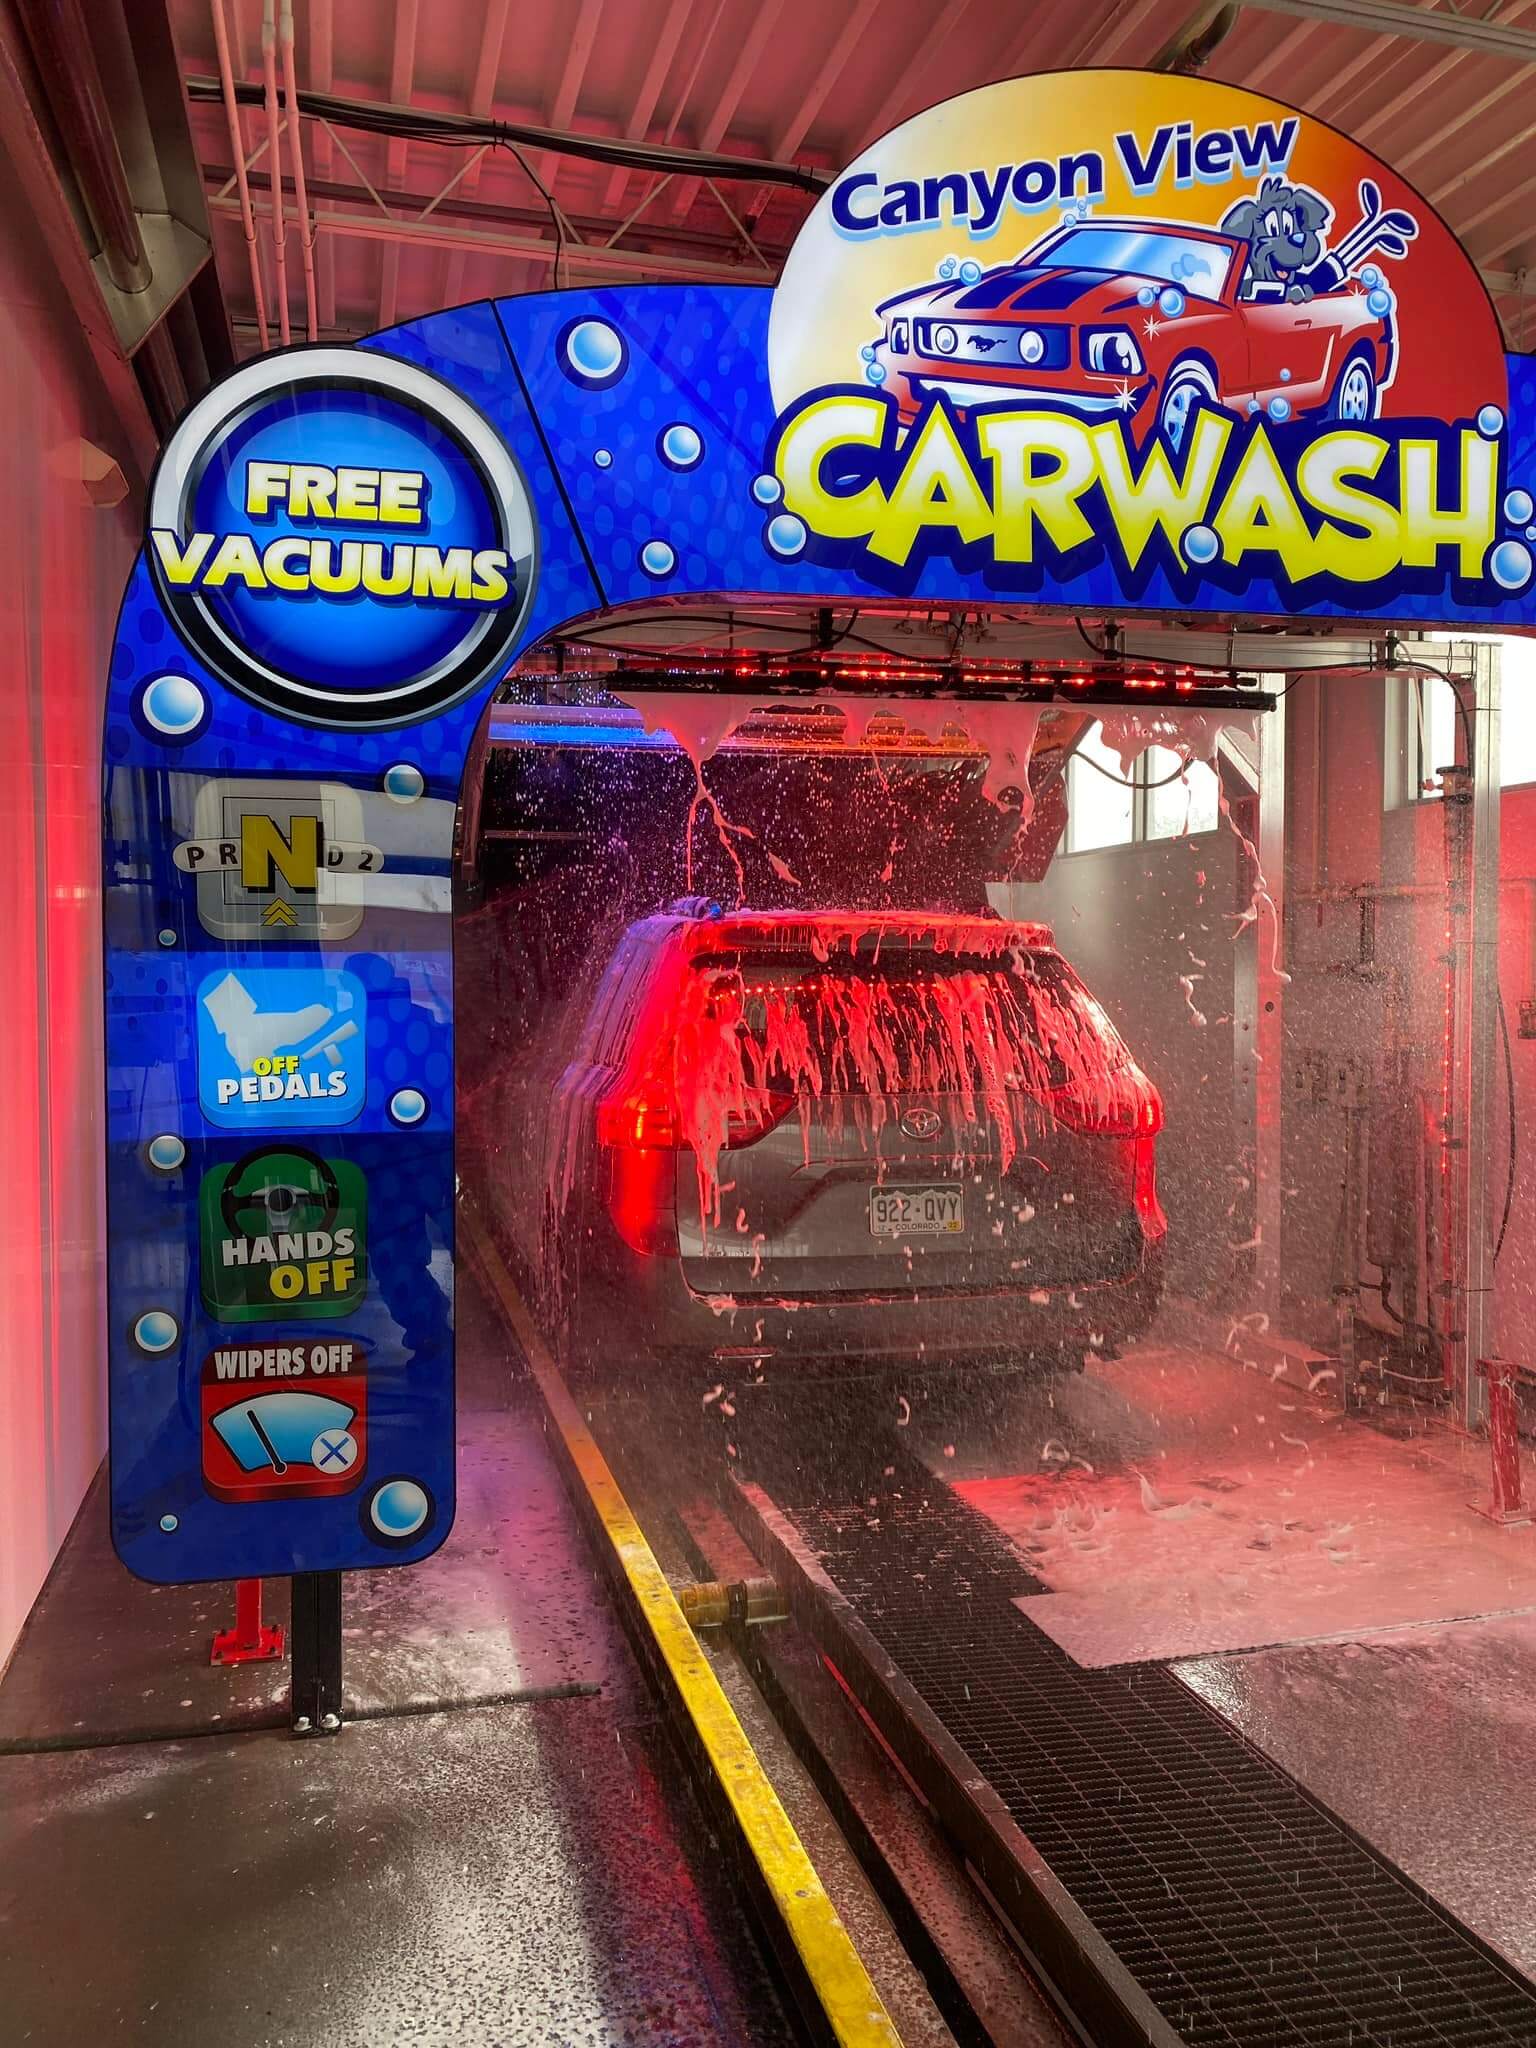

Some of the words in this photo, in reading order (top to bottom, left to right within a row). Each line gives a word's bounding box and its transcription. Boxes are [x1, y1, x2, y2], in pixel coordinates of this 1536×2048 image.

[831, 151, 1104, 233] Canyon
[1112, 118, 1299, 187] View
[246, 461, 424, 525] FREE
[775, 395, 1501, 584] CARWASH
[150, 529, 510, 602] VACUUMS
[252, 1055, 300, 1077] OFF
[217, 1070, 348, 1104] PEDALS
[895, 1222, 940, 1231] COLORADO
[221, 1228, 356, 1267] HANDS
[269, 1259, 356, 1299] OFF
[214, 1346, 306, 1380] WIPERS
[310, 1344, 354, 1374] OFF
